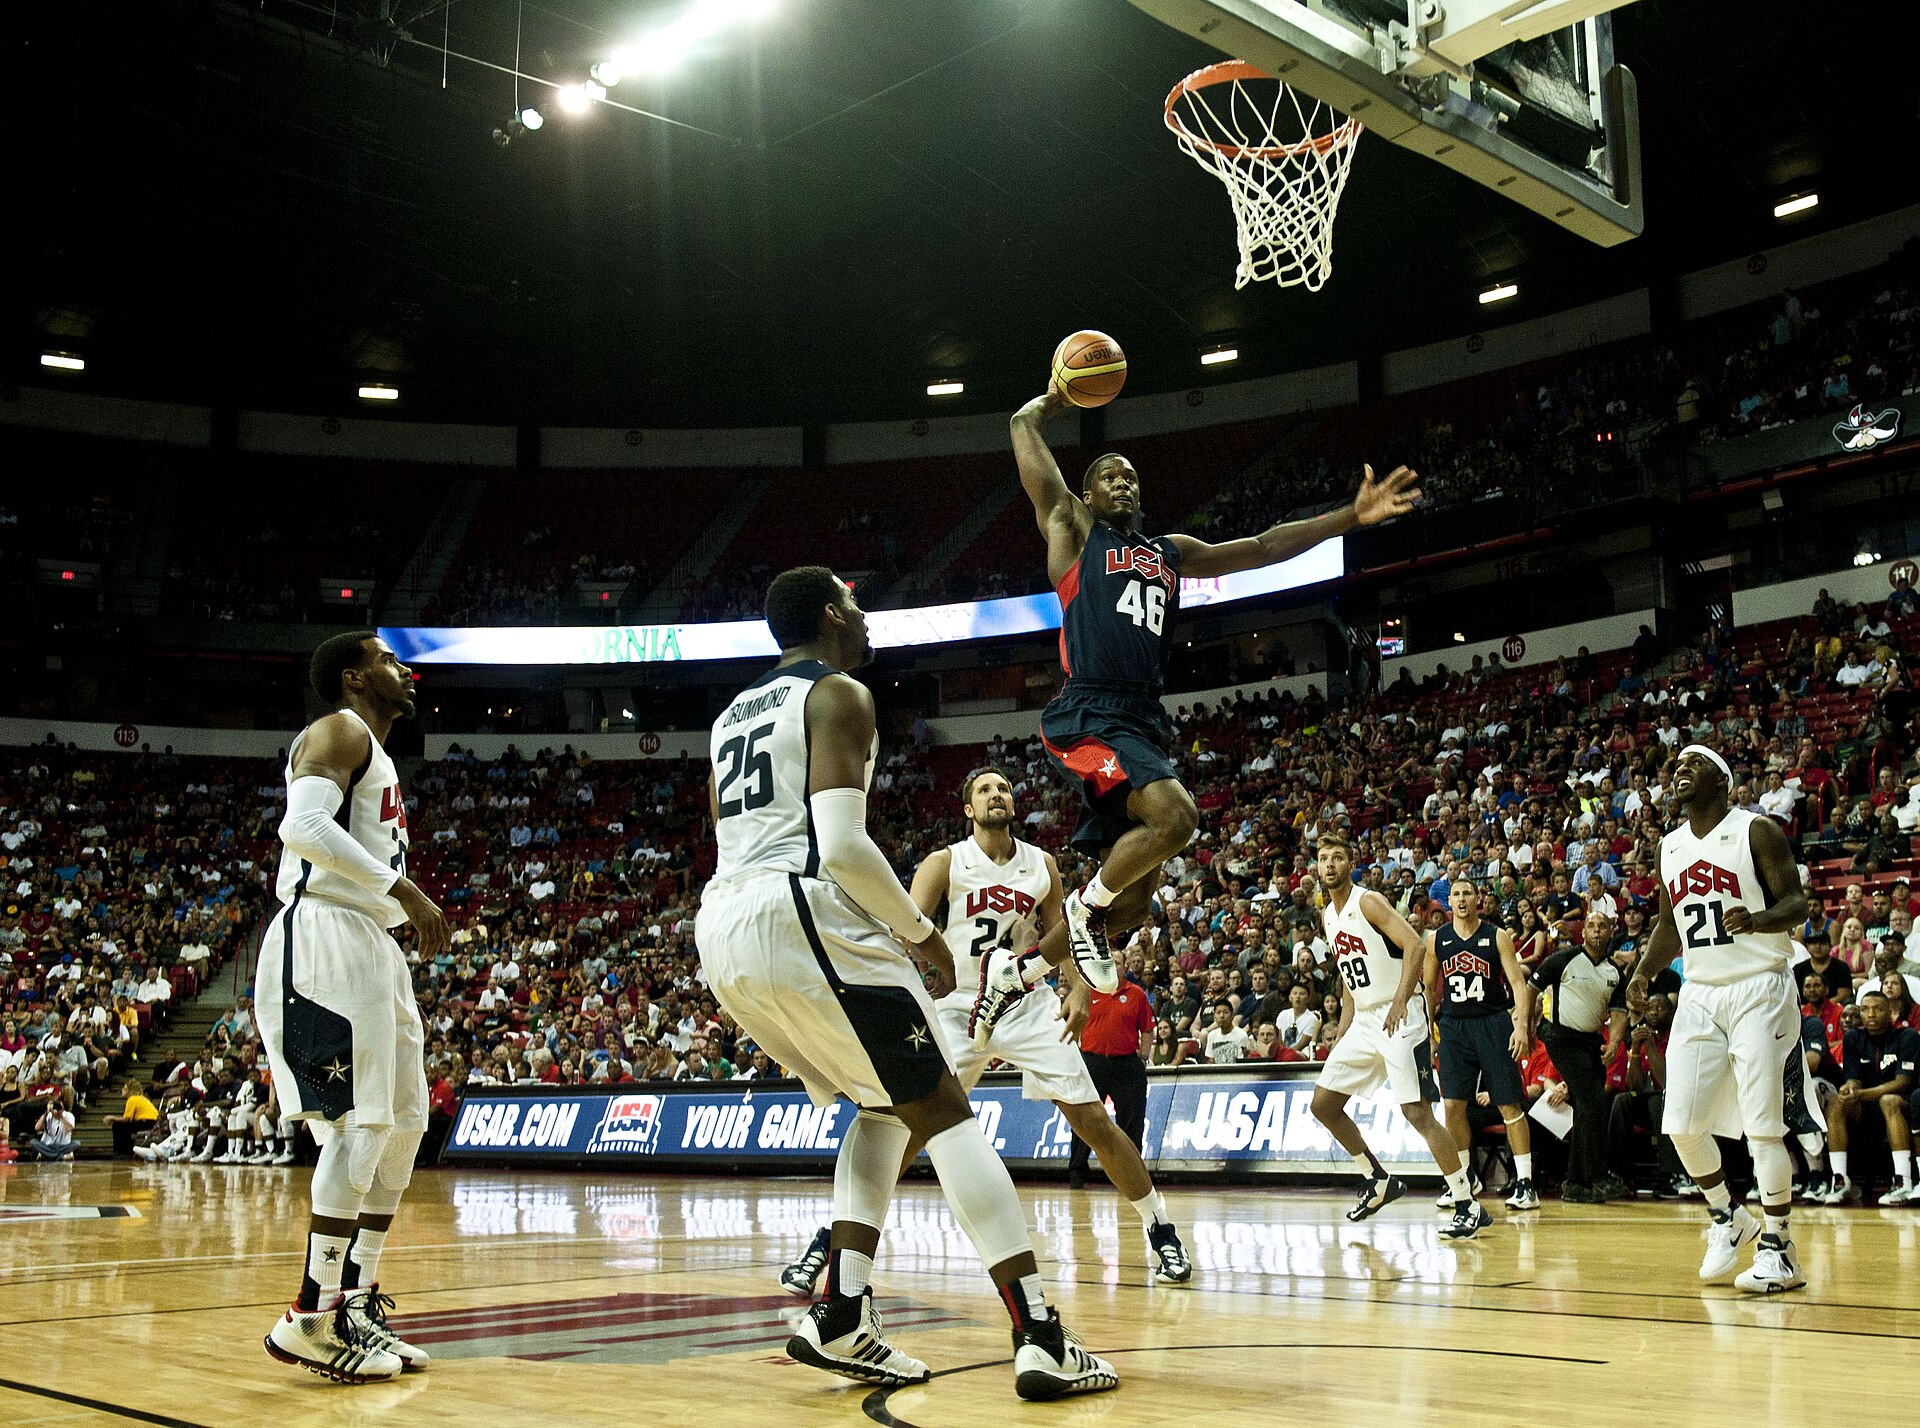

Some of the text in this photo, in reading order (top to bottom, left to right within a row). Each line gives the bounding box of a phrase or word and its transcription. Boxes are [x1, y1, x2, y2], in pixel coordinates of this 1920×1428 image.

[1105, 545, 1177, 600] USA
[1892, 565, 1914, 584] 117
[1116, 579, 1166, 636] 46
[1505, 641, 1522, 657] 116
[723, 685, 792, 728] DRUMMOND
[117, 729, 135, 743] 113
[642, 737, 658, 750] 114
[717, 721, 776, 820] 25
[966, 884, 1036, 919] USA
[1668, 859, 1743, 909] USA
[1683, 899, 1735, 949] 21
[1331, 930, 1368, 961] USA
[1340, 956, 1371, 991] 39
[1442, 950, 1490, 979] USA
[1448, 975, 1485, 1003] 34
[455, 1103, 581, 1147] USAB.COM
[681, 1103, 841, 1149] YOUR GAME.
[590, 1140, 650, 1155] BASKETBALL
